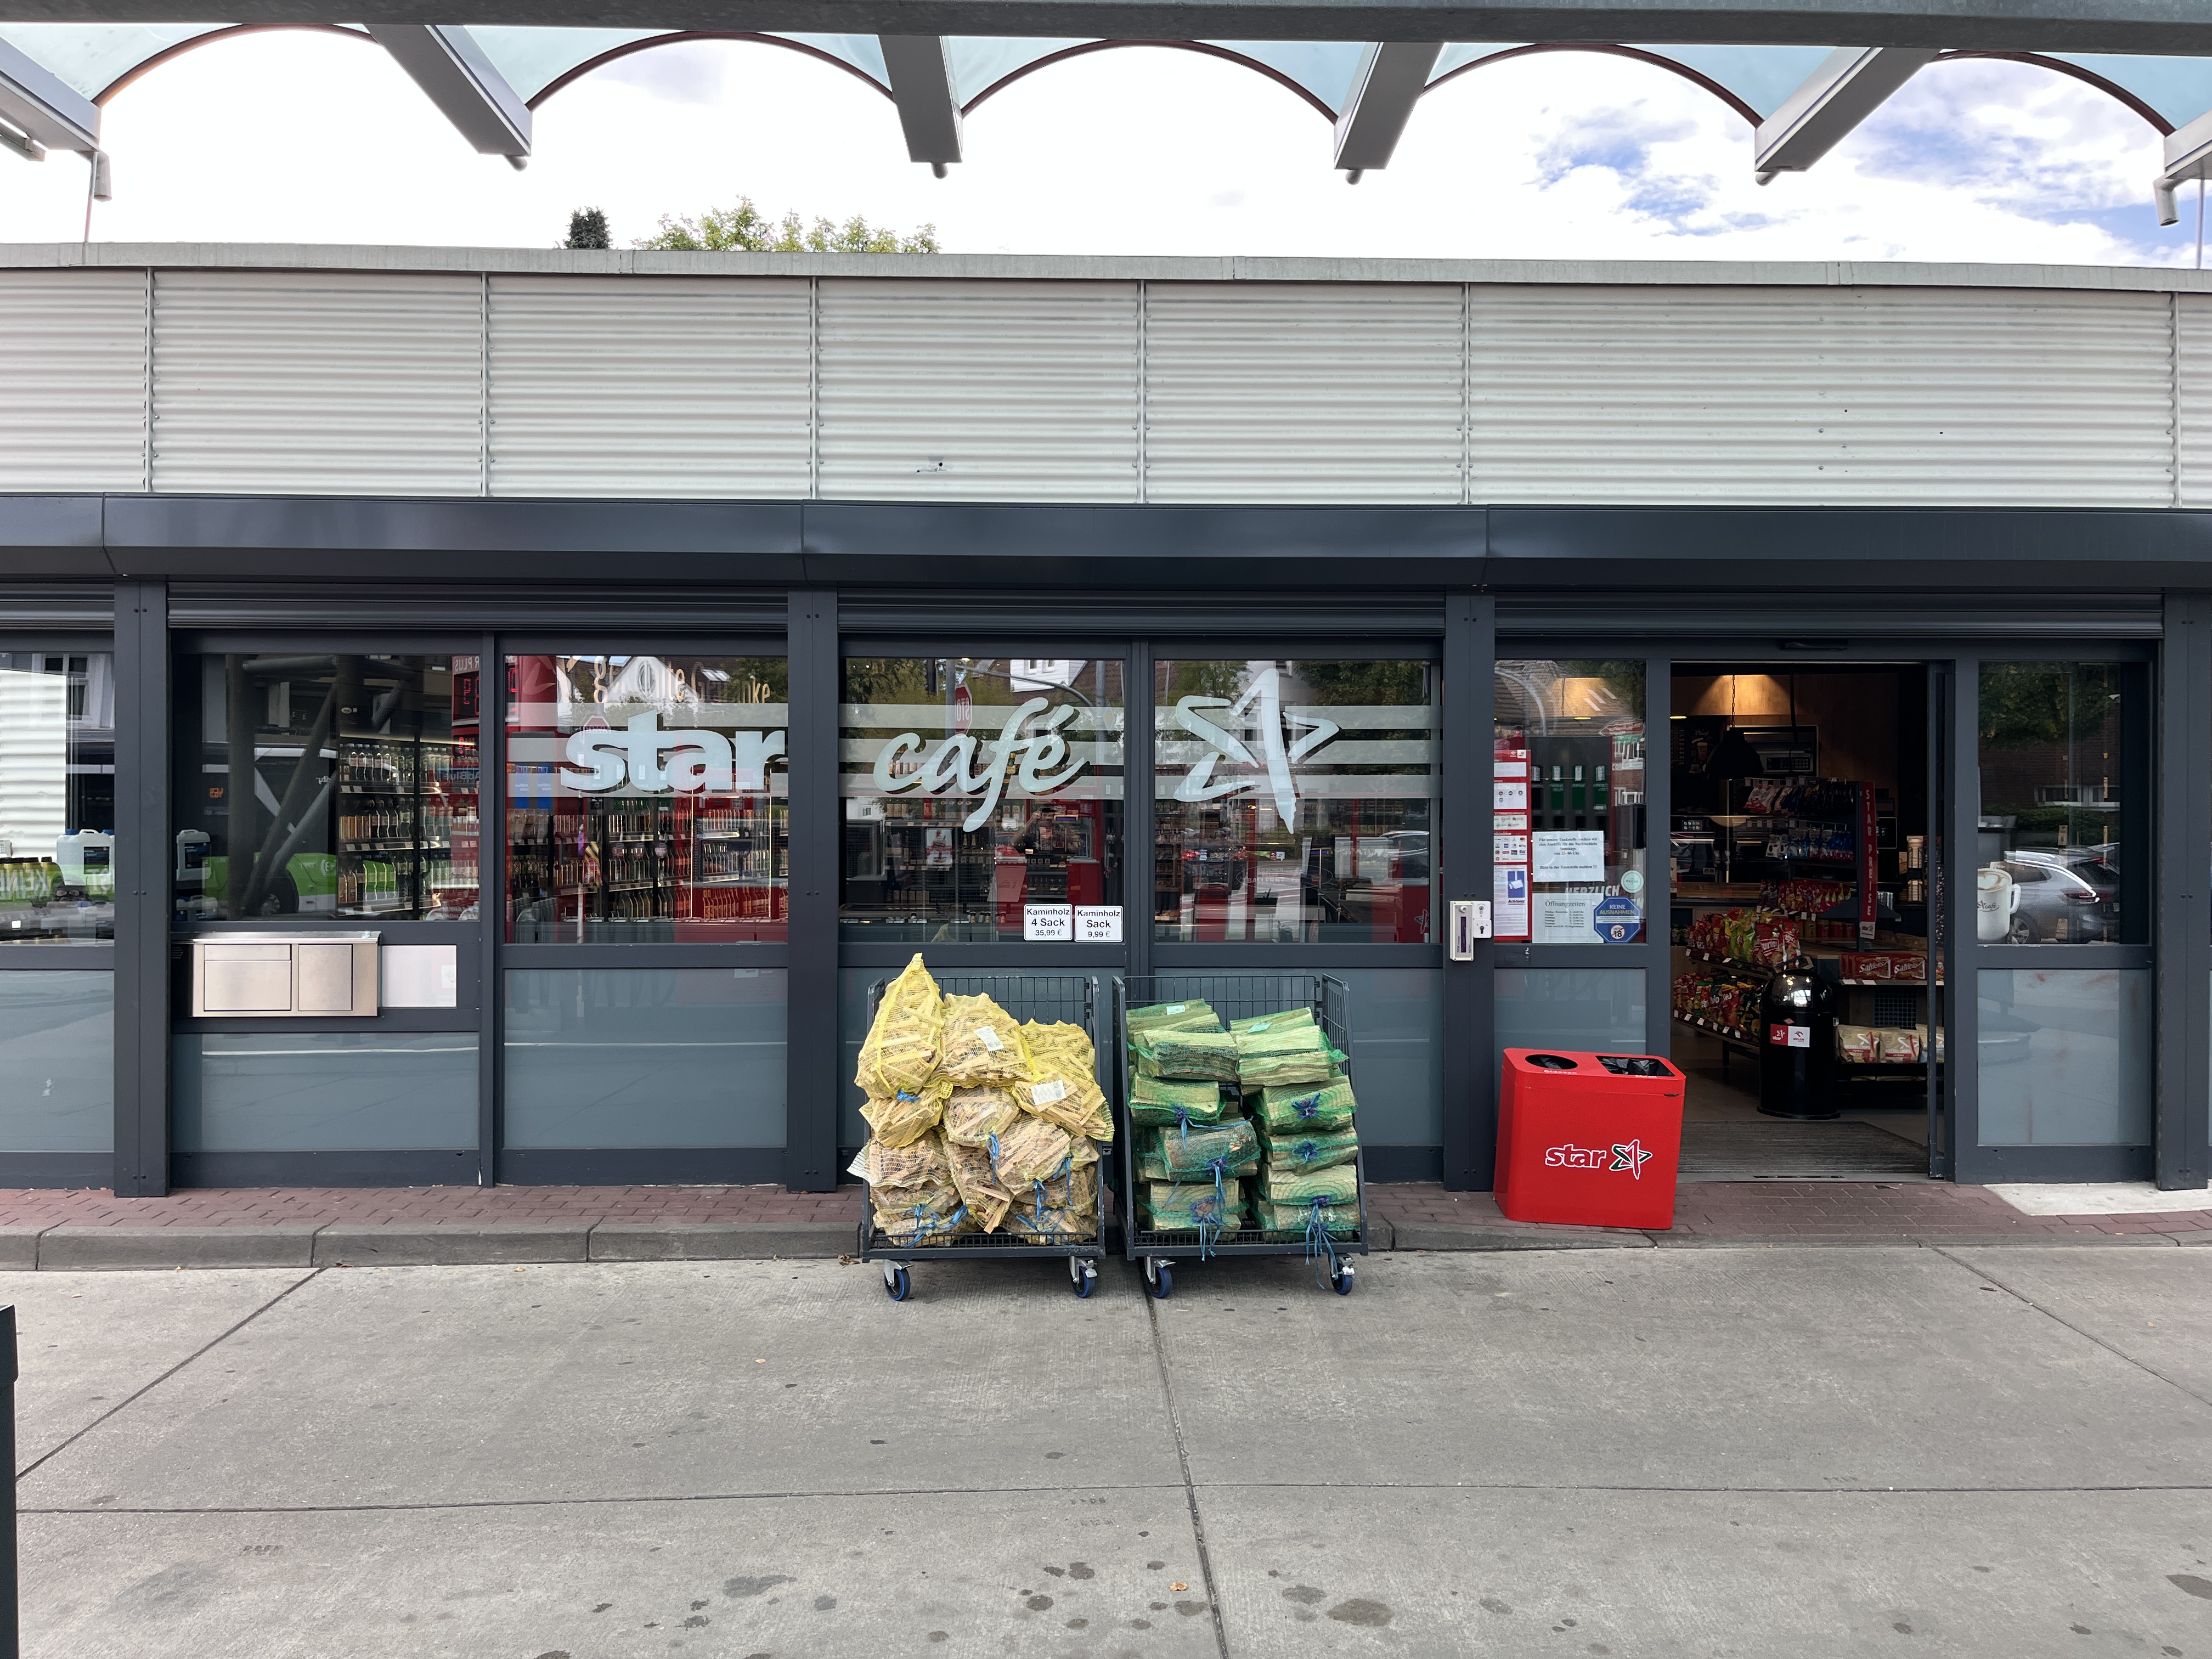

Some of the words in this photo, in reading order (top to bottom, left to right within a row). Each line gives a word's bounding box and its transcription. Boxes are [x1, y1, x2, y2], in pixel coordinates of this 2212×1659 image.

[560, 710, 786, 791] star
[874, 697, 1085, 832] café
[1545, 1143, 1606, 1169] star
